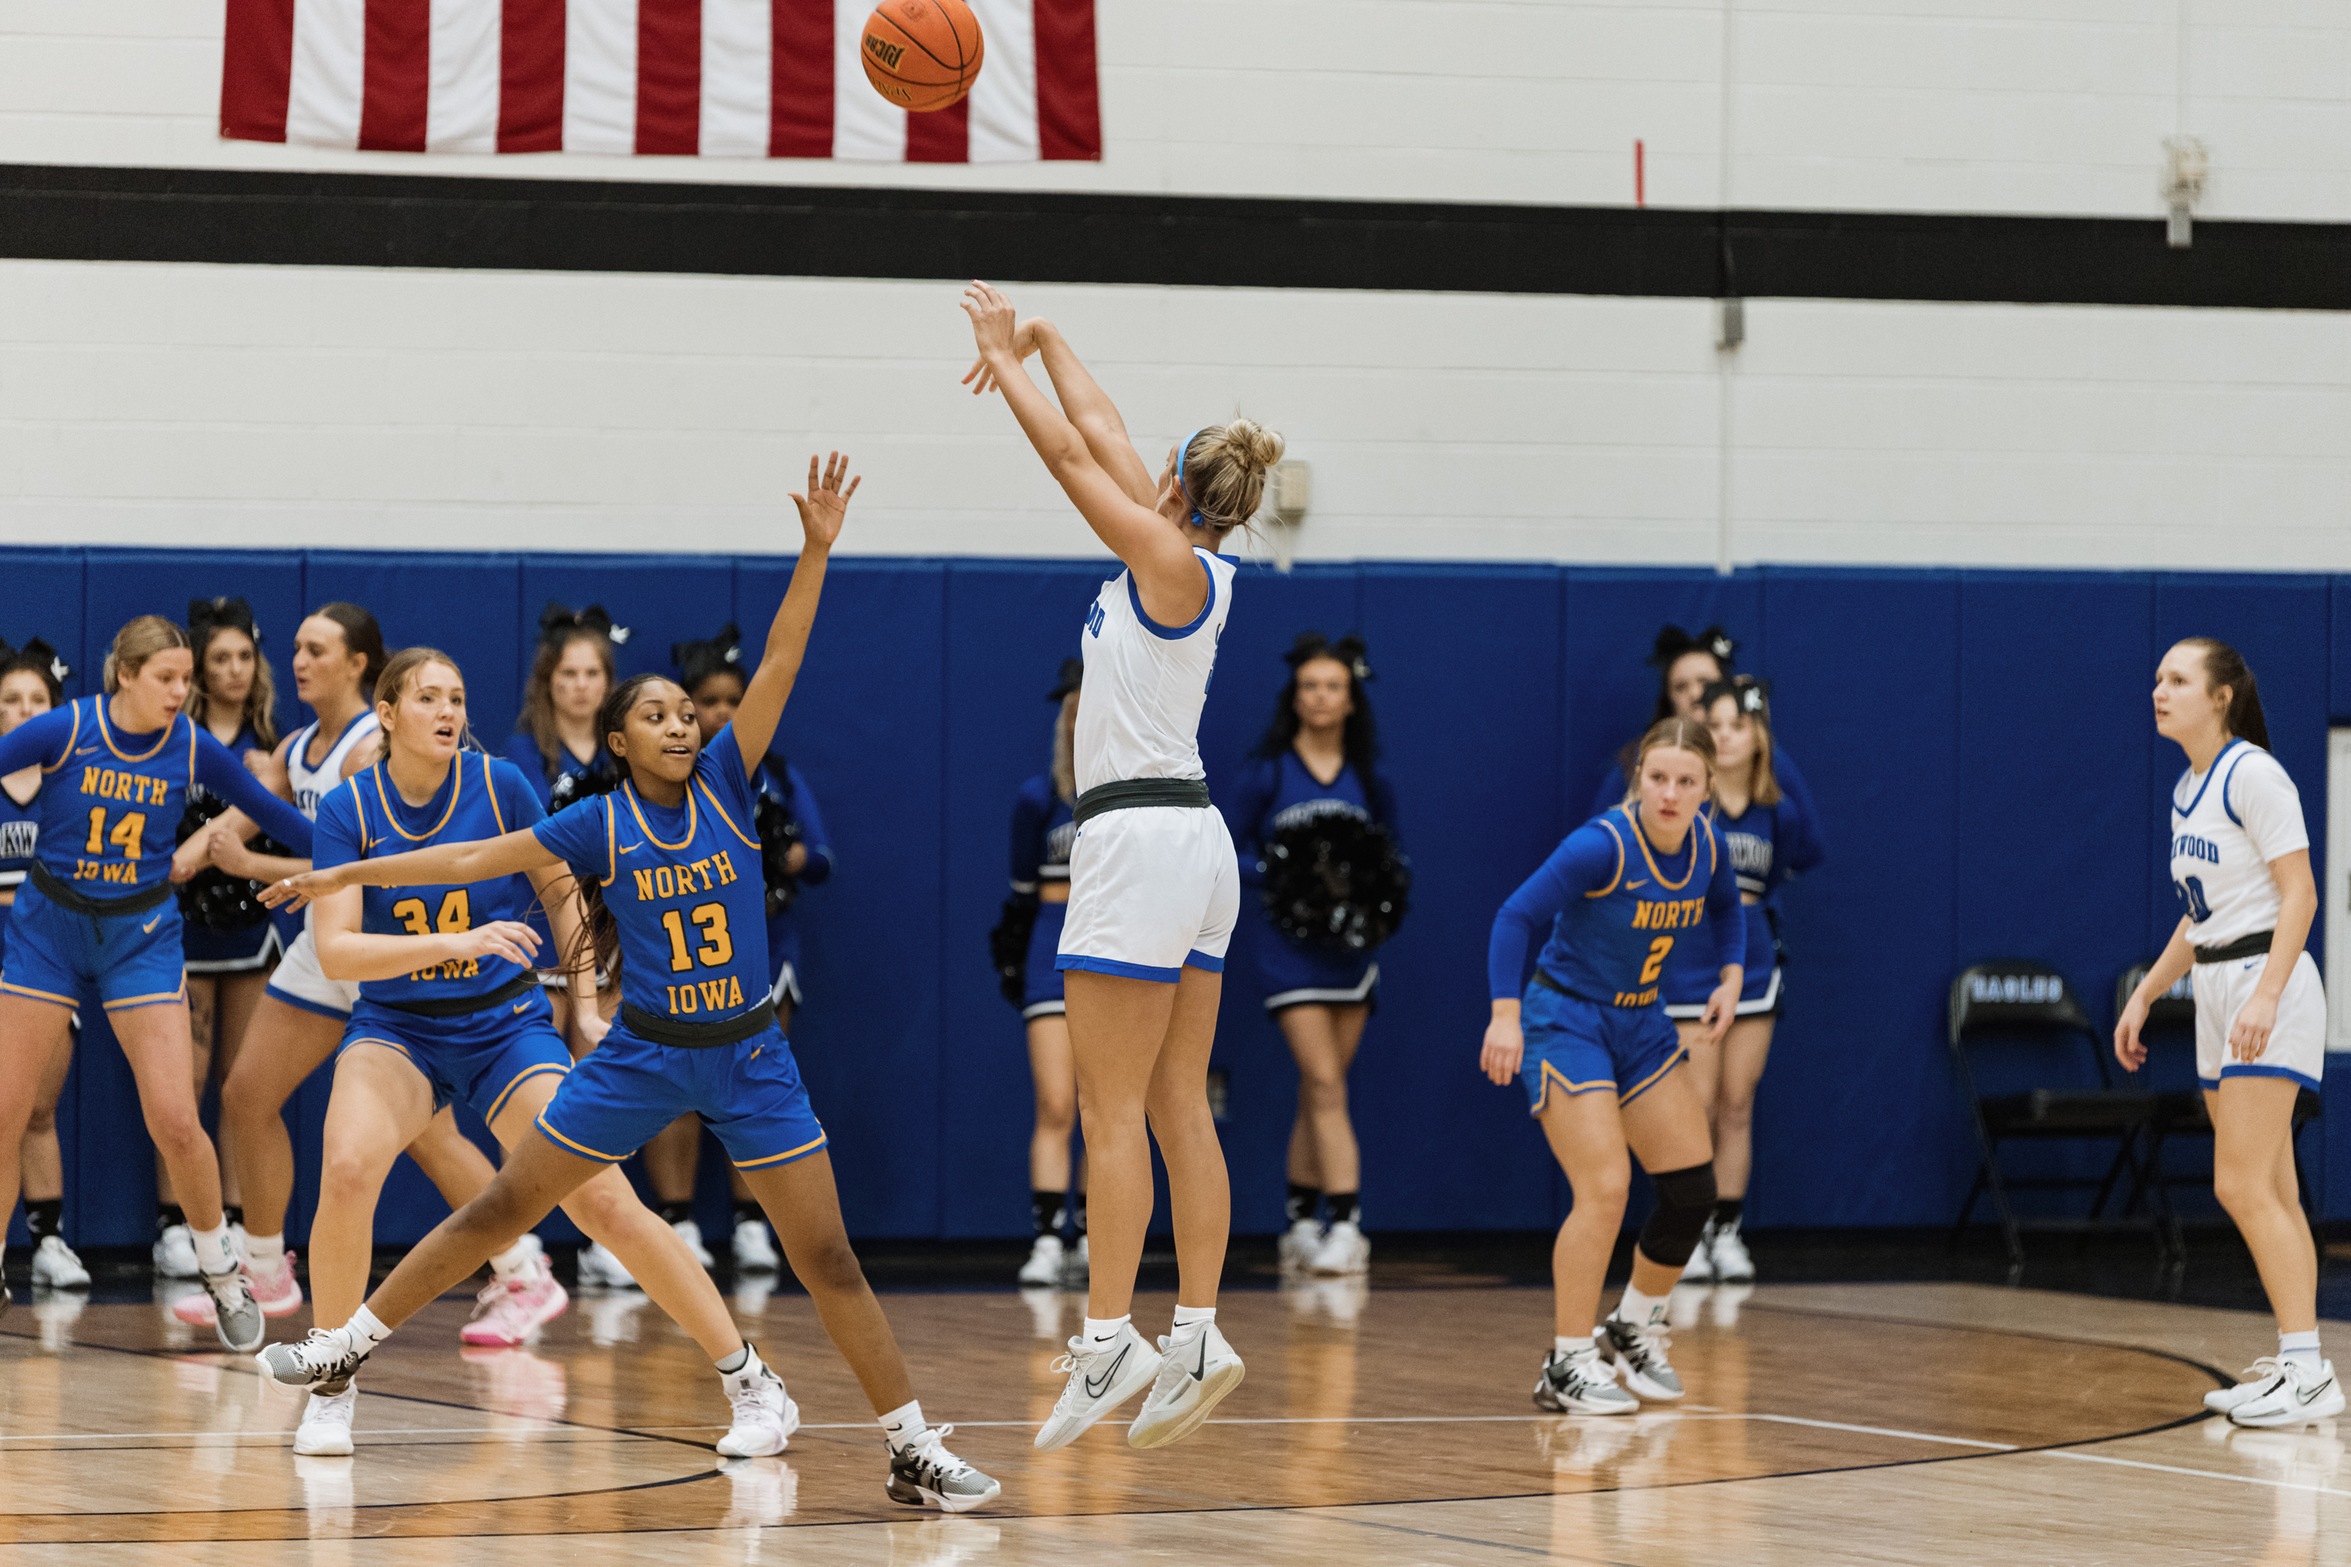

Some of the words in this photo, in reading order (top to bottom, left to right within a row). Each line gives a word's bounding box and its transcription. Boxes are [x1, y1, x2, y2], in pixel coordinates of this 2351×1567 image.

[80, 766, 169, 806] NORTH
[86, 806, 146, 860] 14
[2171, 835, 2219, 864] WOOD
[73, 859, 138, 884] IOWA
[633, 849, 738, 901] NORTH
[392, 888, 471, 936] 34
[1631, 895, 1705, 930] NORTH
[661, 900, 735, 973] 13
[1639, 935, 1675, 986] 2
[667, 975, 744, 1015] IOWA
